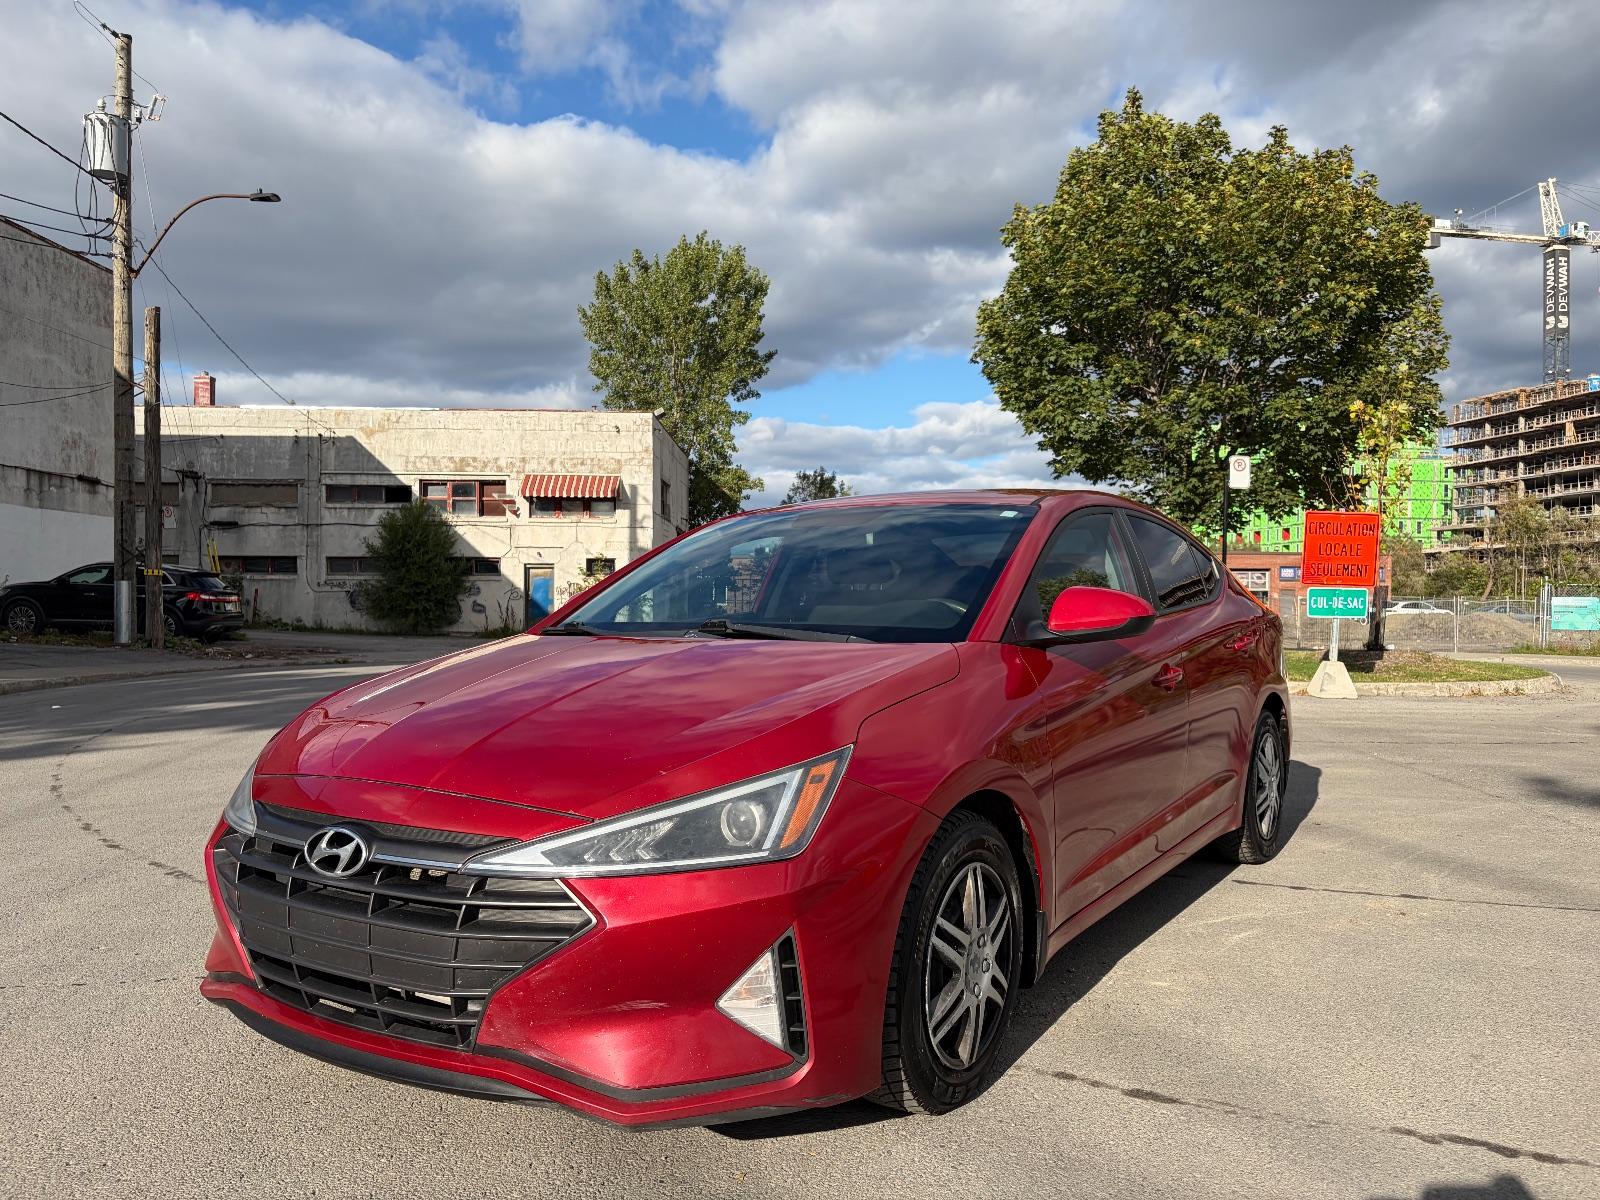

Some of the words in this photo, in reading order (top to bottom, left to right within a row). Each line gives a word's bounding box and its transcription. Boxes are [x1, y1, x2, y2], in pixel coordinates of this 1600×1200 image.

[1546, 257, 1555, 313] DEVWAH
[1558, 256, 1568, 312] DEVWAH
[1308, 522, 1375, 536] CIRCULATION
[1319, 543, 1362, 556] LOCALE
[1310, 563, 1369, 577] SEULEMENT
[1310, 597, 1364, 609] CUL-DE-SAC
